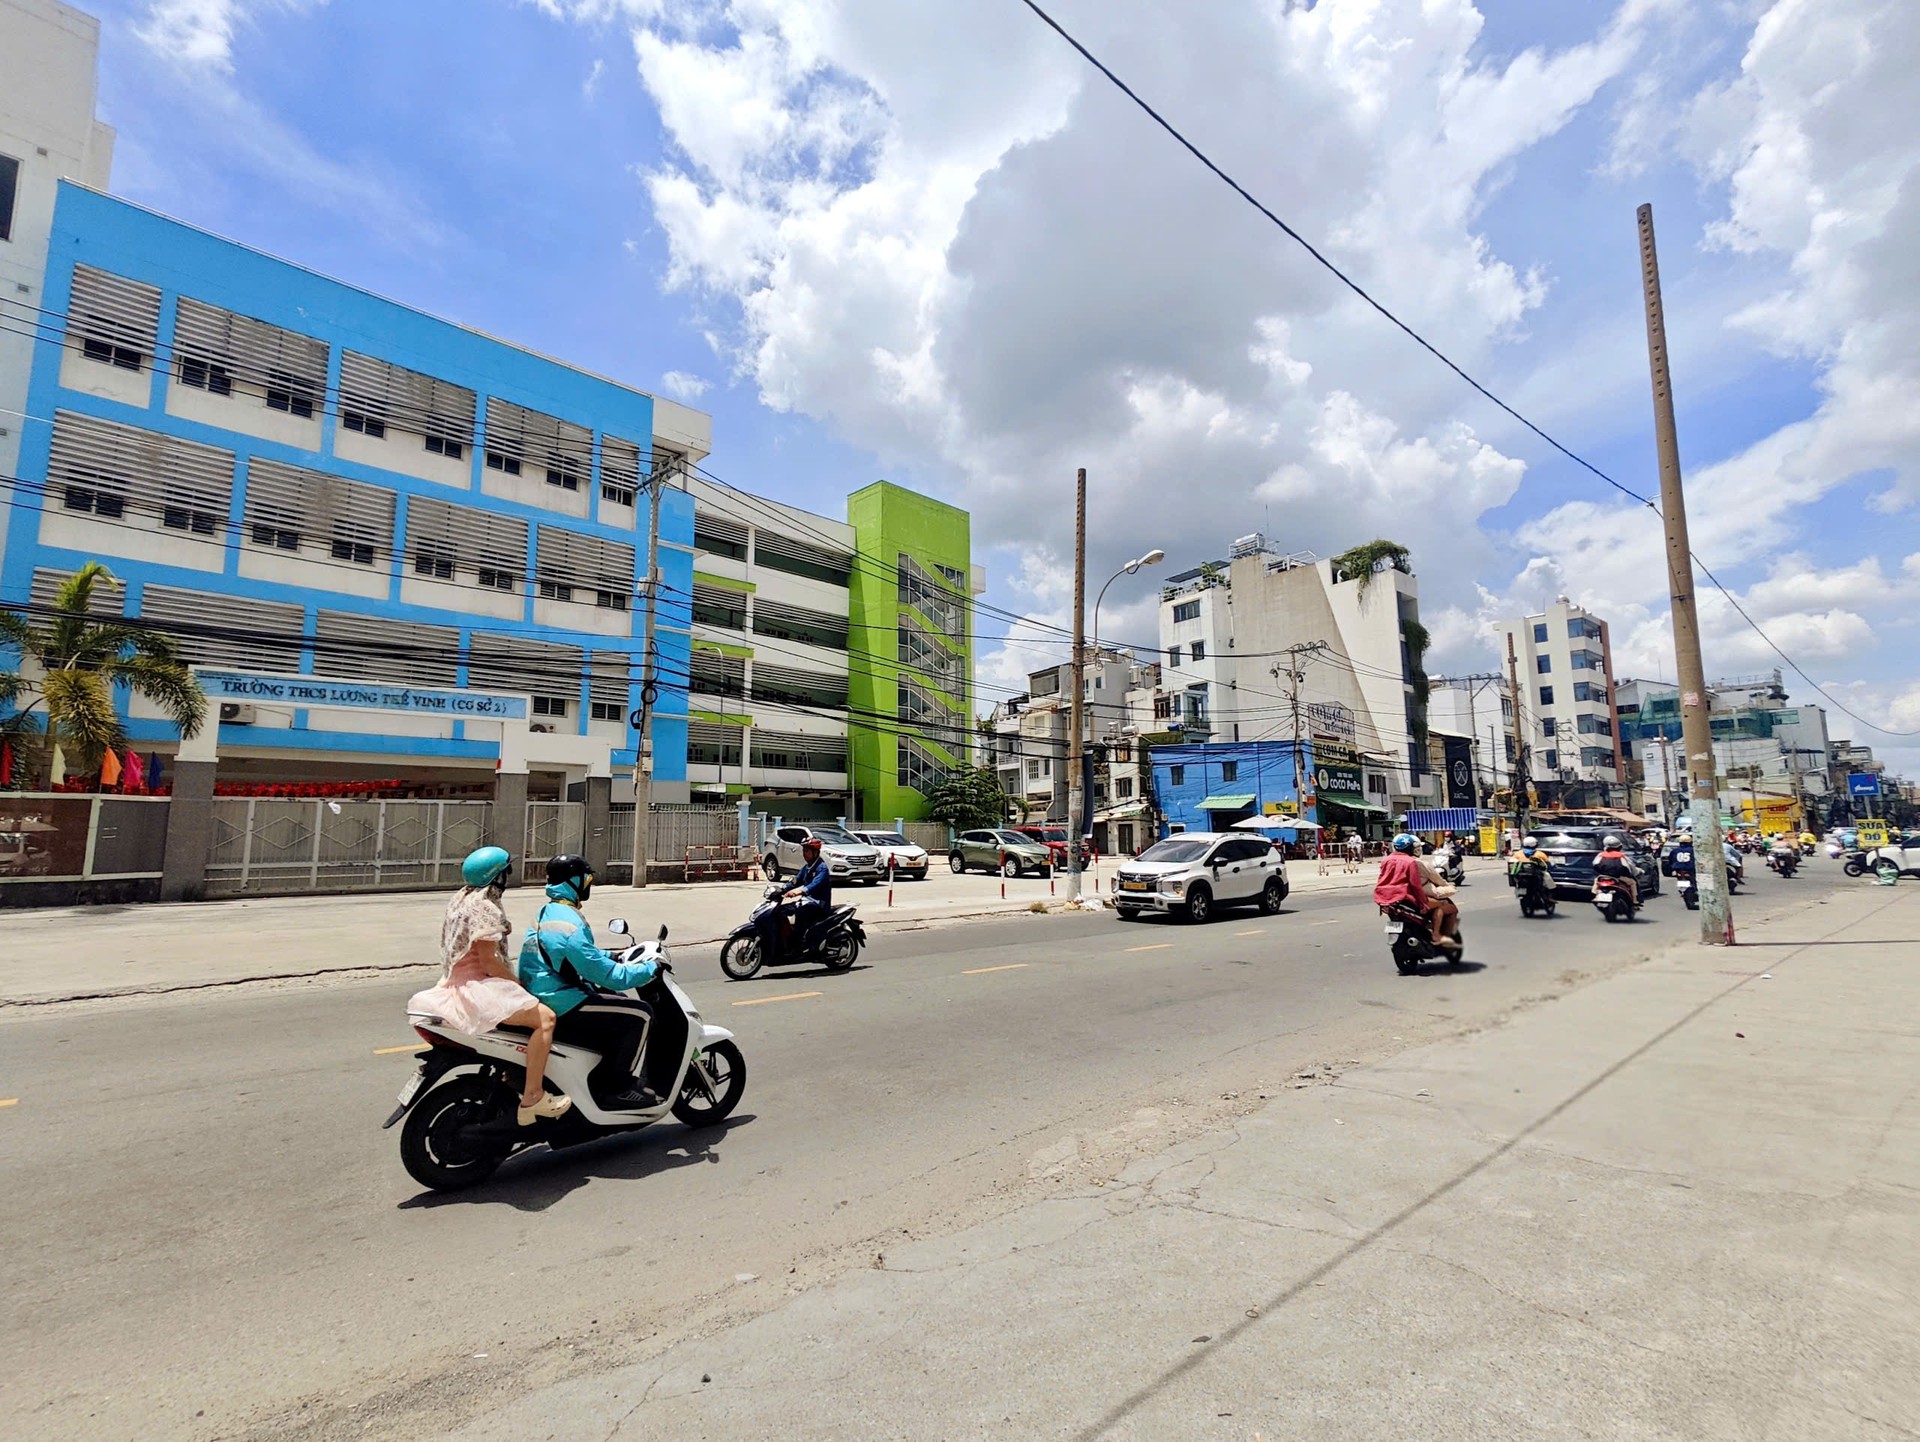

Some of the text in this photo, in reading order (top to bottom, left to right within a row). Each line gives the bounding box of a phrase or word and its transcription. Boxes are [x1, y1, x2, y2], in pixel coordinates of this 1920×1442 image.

[221, 678, 284, 697] TRƯỜNG
[288, 686, 327, 699] THCS
[330, 689, 377, 703] LƯƠNG
[412, 695, 446, 708] VINH
[1329, 778, 1346, 790] COCO
[1676, 851, 1691, 863] 05
